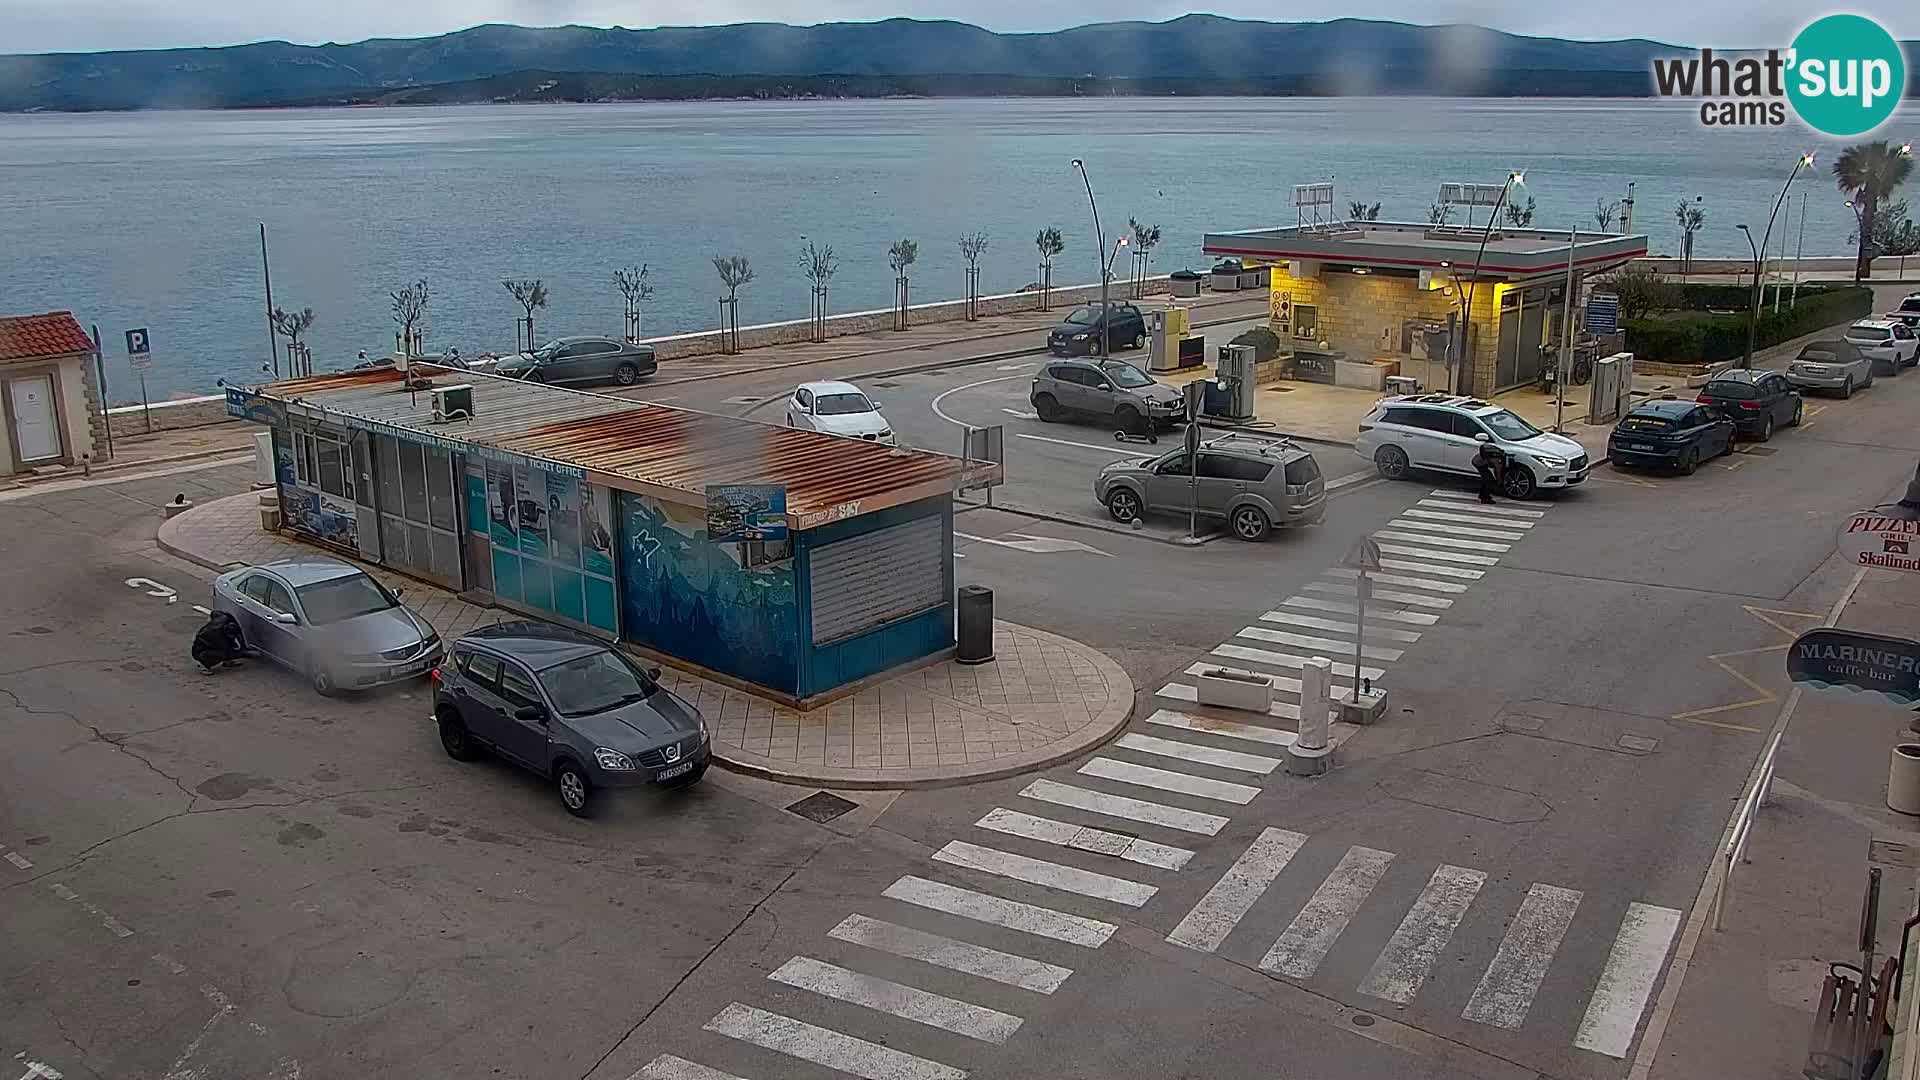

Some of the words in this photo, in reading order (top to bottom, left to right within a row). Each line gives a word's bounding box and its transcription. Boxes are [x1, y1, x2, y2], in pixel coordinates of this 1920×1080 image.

[131, 332, 143, 350] P
[437, 440, 469, 453] POSTAJA
[529, 459, 555, 473] TICKET
[556, 464, 583, 479] OFFICE
[1847, 517, 1920, 536] PIZZE
[1880, 532, 1914, 542] GRILL
[1858, 551, 1920, 571] Skalinad
[1827, 663, 1864, 676] caffe
[1869, 667, 1896, 681] bar
